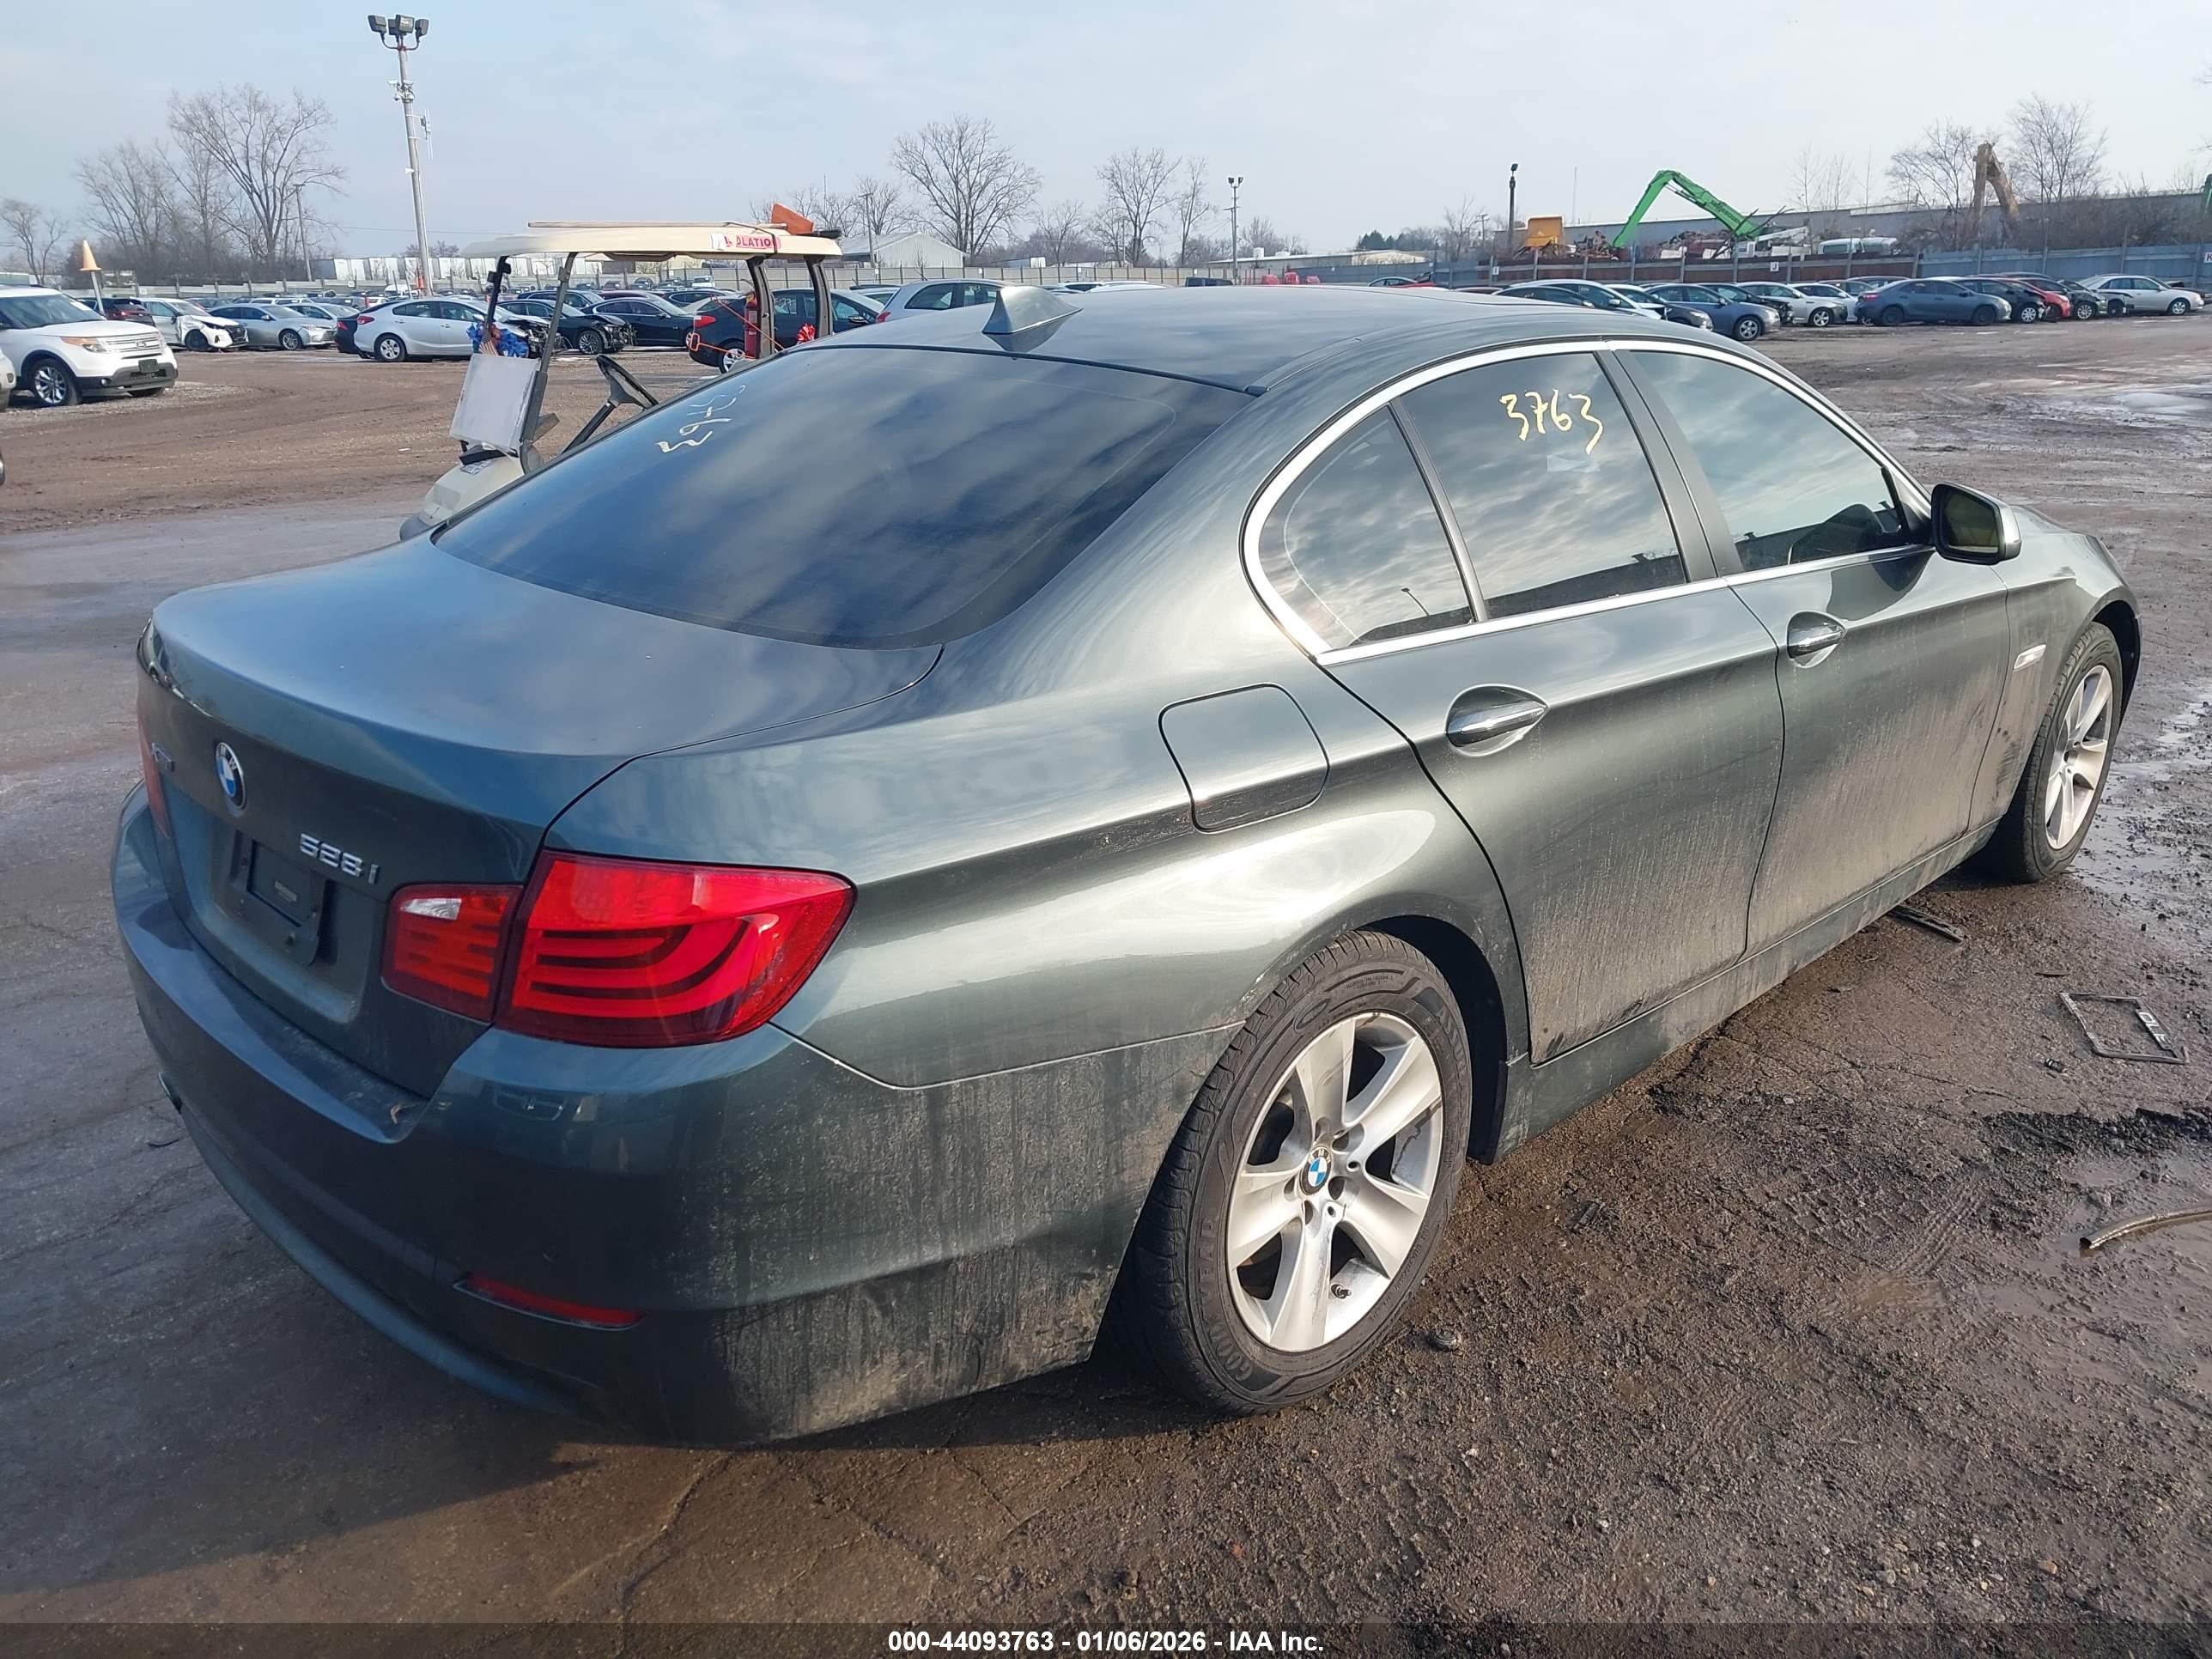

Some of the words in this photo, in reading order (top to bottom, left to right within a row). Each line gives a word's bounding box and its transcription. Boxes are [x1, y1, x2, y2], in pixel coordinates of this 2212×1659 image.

[1499, 388, 1603, 454] 3763
[300, 833, 379, 884] 528i
[1307, 1148, 1332, 1164] BMW
